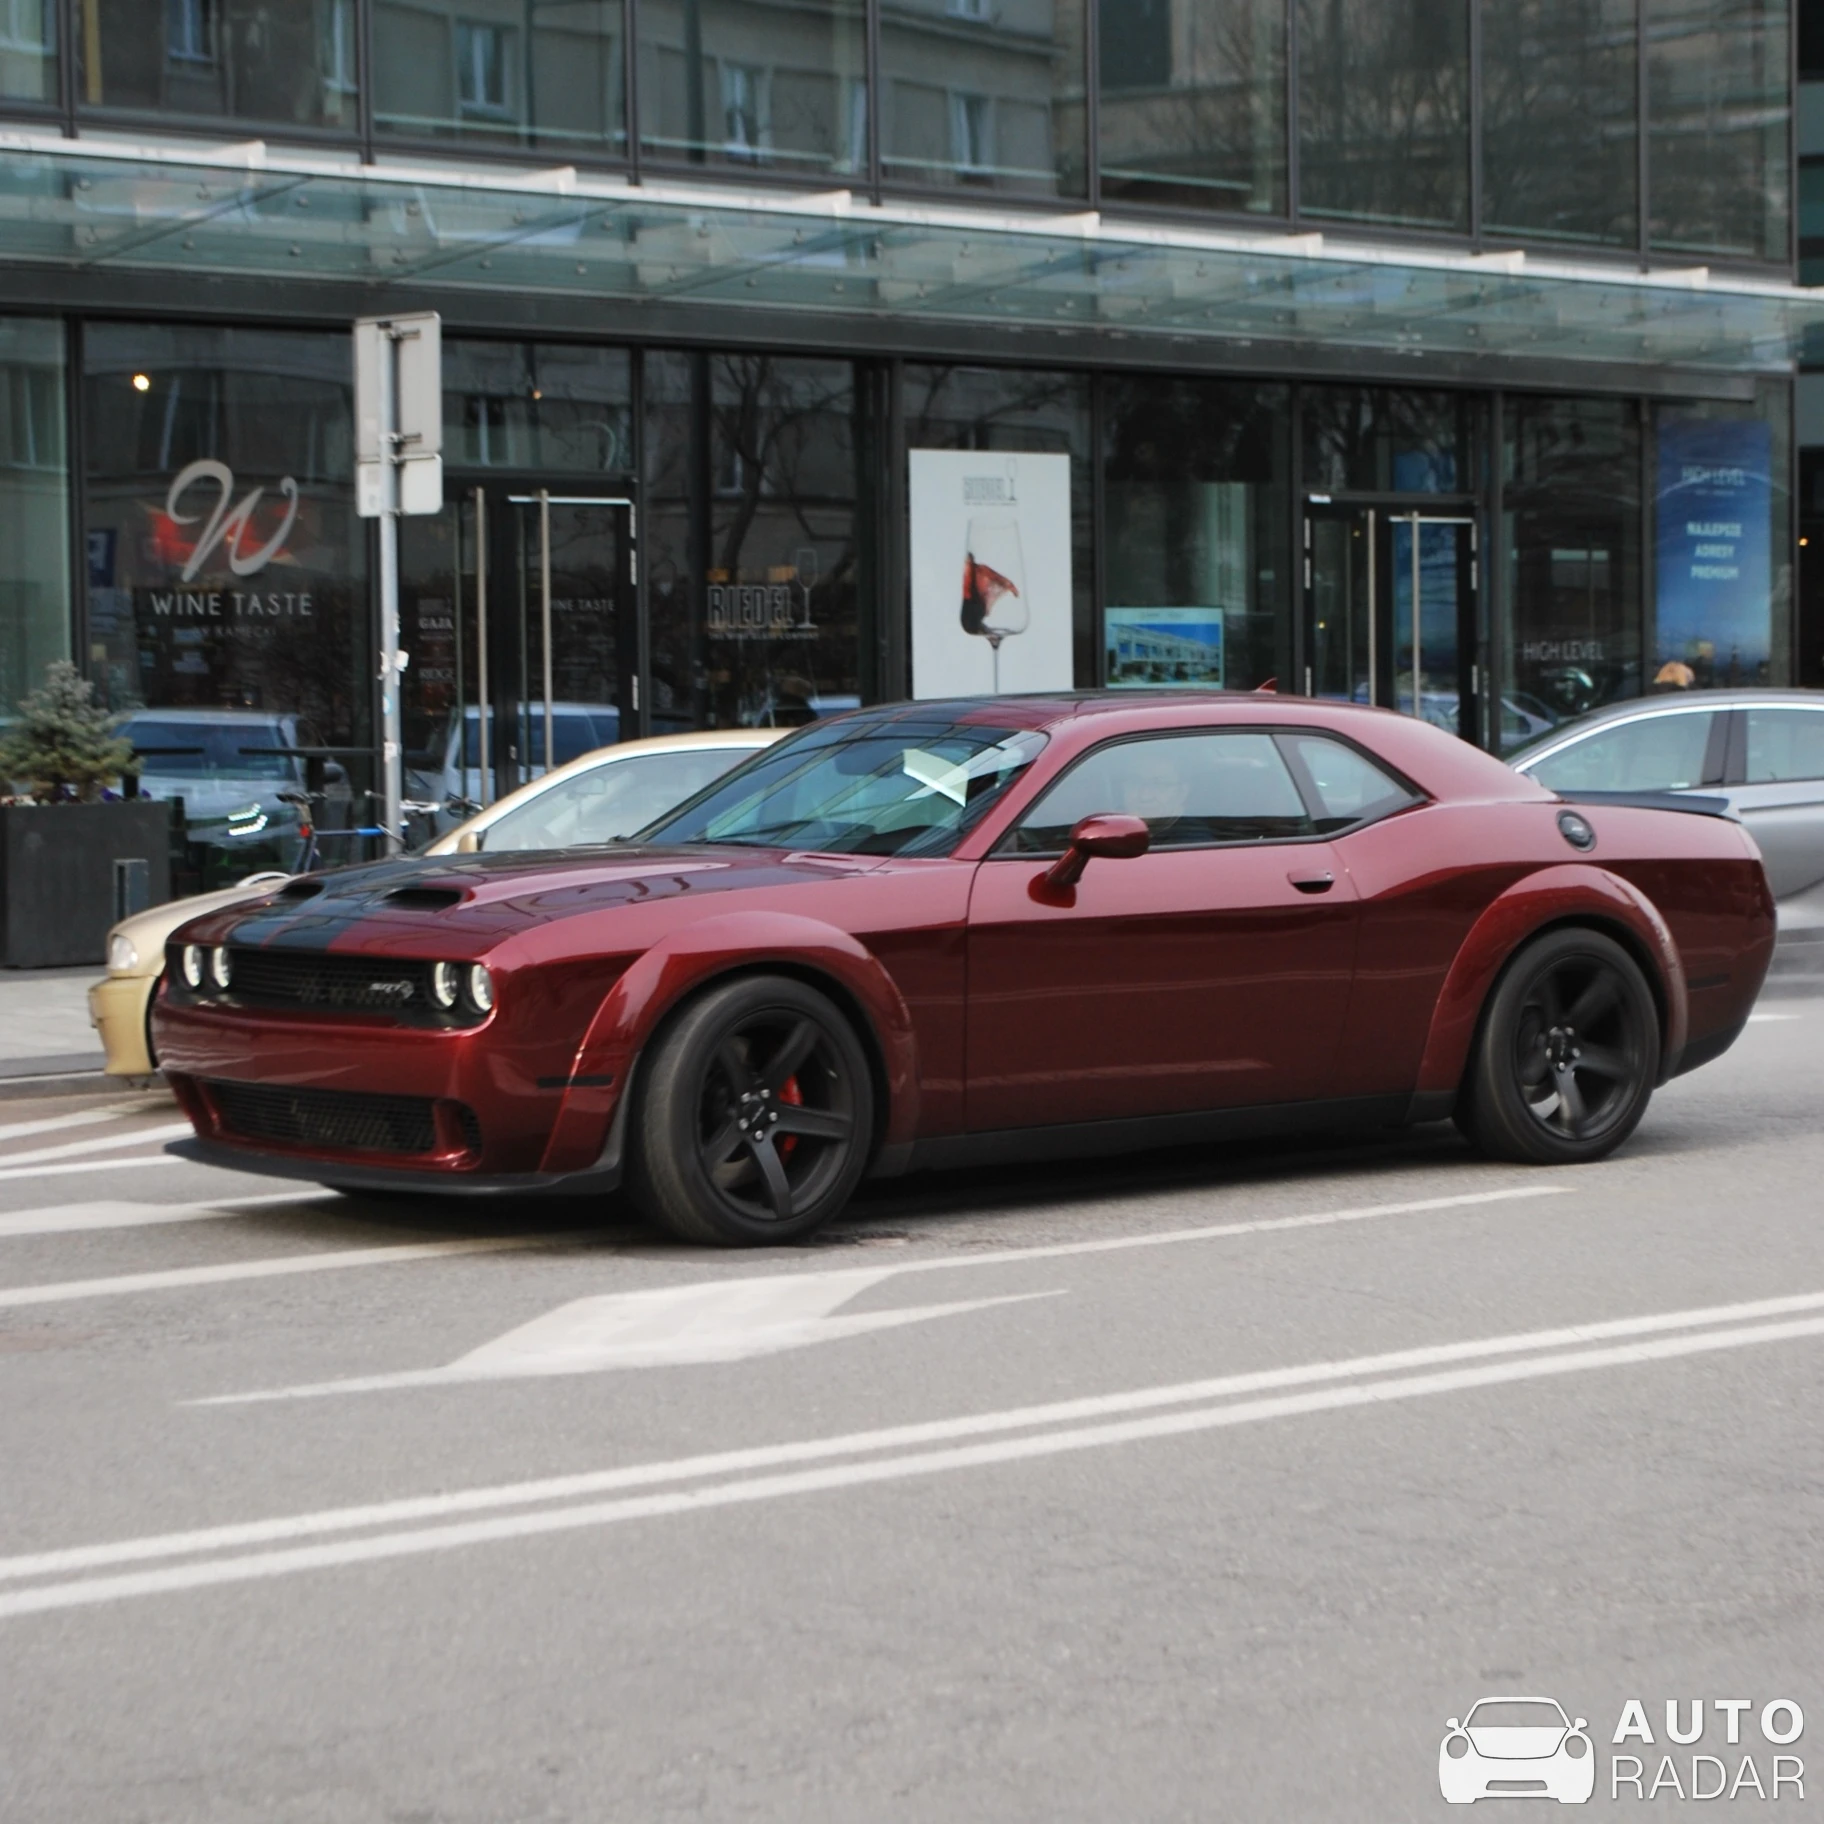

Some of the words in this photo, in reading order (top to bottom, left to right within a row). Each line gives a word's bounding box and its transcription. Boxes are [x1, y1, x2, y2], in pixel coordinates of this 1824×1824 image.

[150, 592, 222, 616] WINE
[233, 592, 313, 616] TASTE
[577, 599, 616, 613] TASTE
[707, 585, 794, 629] RIEDEL
